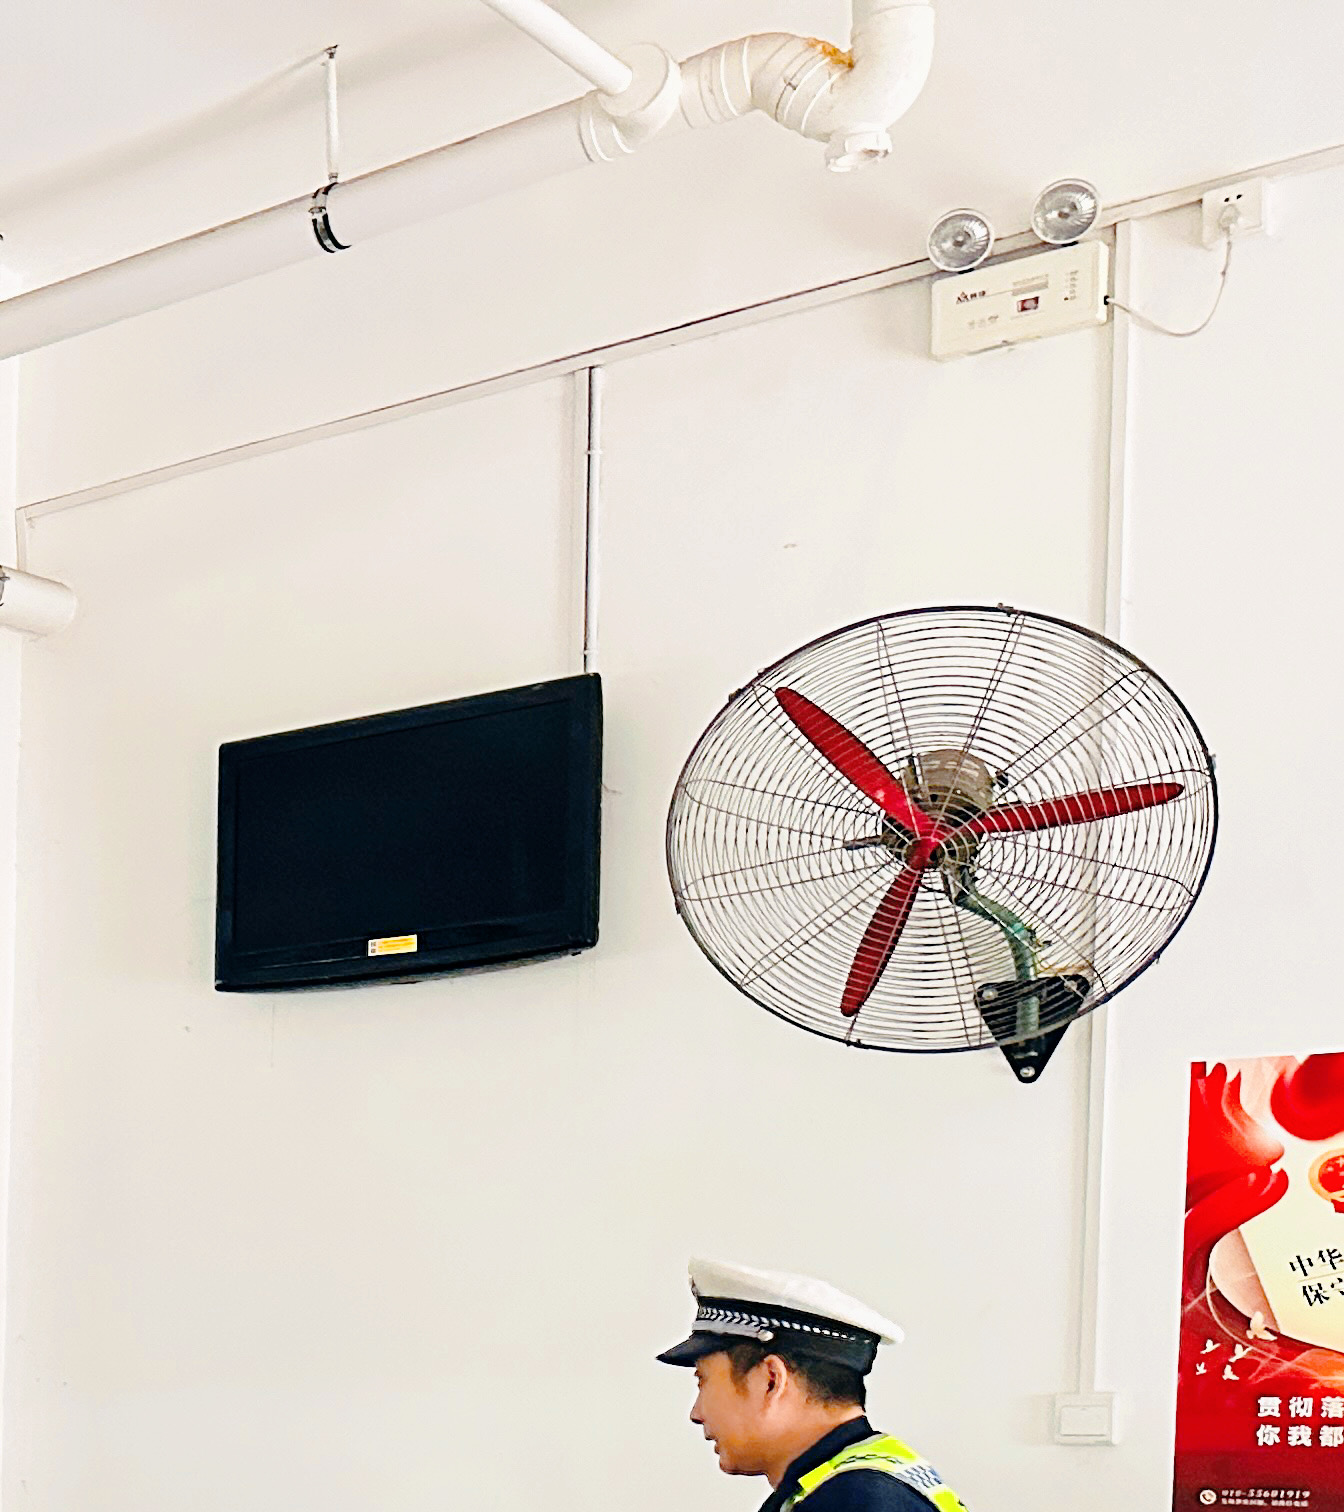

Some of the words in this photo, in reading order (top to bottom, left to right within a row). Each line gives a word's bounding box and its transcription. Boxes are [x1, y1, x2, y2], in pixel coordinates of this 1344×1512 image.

[1289, 1247, 1344, 1277] 中华
[1256, 1424, 1344, 1447] 你我都
